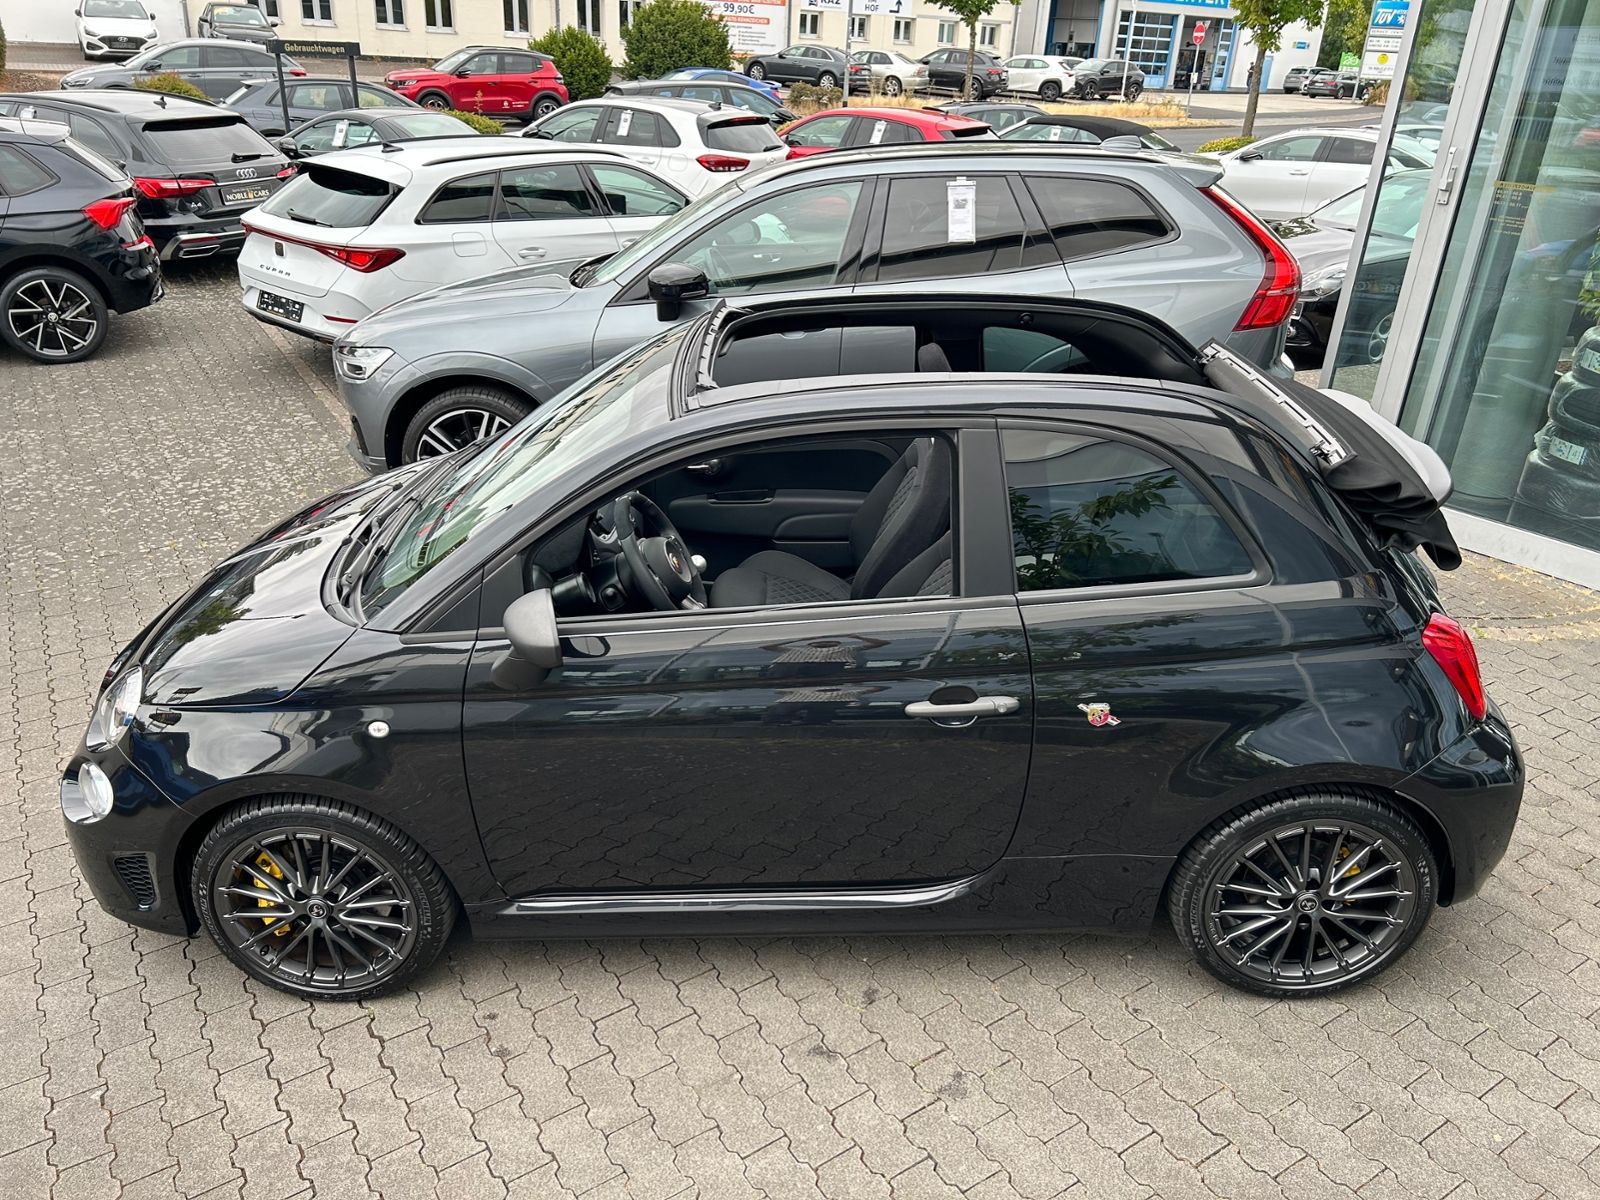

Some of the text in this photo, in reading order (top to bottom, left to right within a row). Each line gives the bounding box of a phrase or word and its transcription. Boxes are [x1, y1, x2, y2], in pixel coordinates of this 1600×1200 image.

[723, 2, 755, 14] 99,90€
[864, 4, 879, 12] HOF
[284, 43, 345, 55] Gebrauchtwagen
[226, 192, 248, 201] NOBLE
[253, 189, 270, 197] CARS
[259, 264, 291, 277] CUPRA
